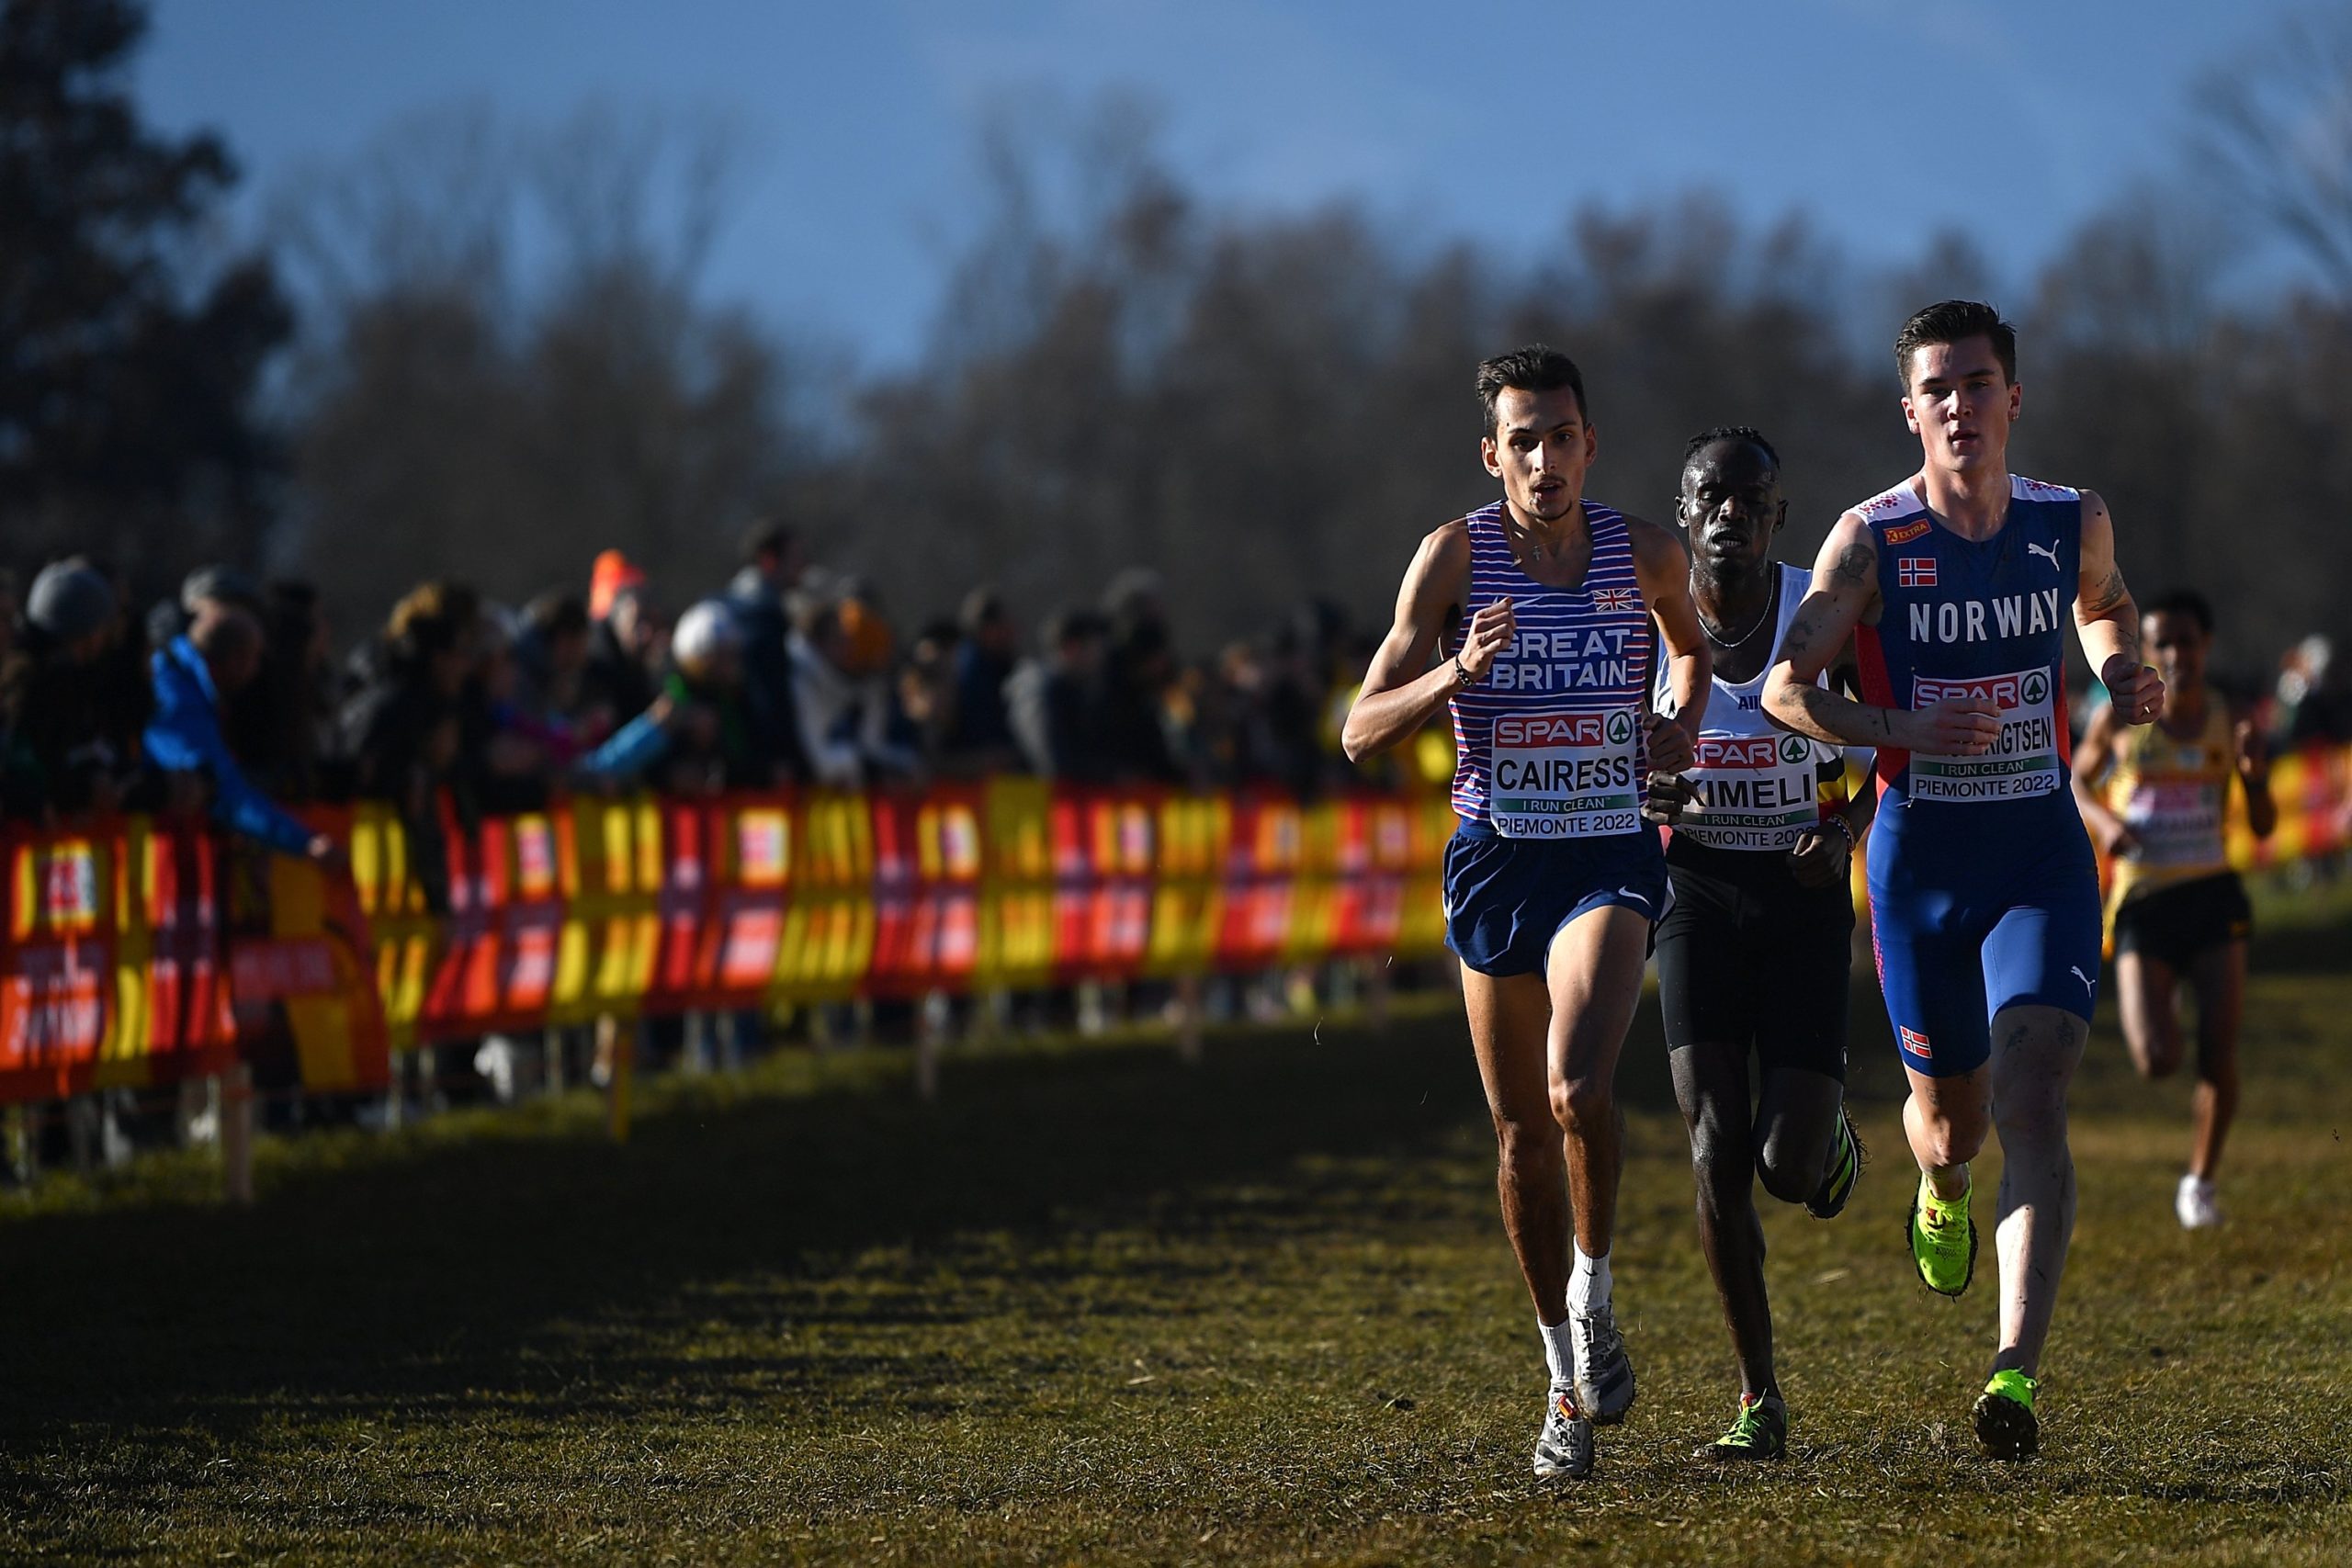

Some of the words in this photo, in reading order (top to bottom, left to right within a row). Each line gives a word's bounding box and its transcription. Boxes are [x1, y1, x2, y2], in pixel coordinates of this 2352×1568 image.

[1909, 587, 2059, 643] NORWAY
[1495, 628, 1631, 659] GREAT
[1491, 660, 1627, 690] BRITAIN
[1737, 694, 1762, 710] All
[1917, 682, 2016, 706] SPAR
[1498, 719, 1600, 744] SPAR
[1496, 755, 1630, 793] CAIRESS
[1940, 764, 1945, 774] I
[1948, 765, 1976, 776] RUN
[1981, 761, 2024, 774] CLEAN
[1916, 779, 2008, 797] PIEMONTE
[2012, 773, 2055, 794] 2022
[1523, 800, 1527, 811] I
[1531, 799, 1559, 812] RUN
[1563, 796, 1605, 812] CLEAN
[1498, 817, 1589, 835] PIEMONTE
[1593, 813, 1635, 831] 2022
[1704, 815, 1708, 824] I
[1712, 814, 1739, 826] RUN
[1742, 815, 1785, 827] CLEAN
[1684, 827, 1770, 846] PIEMONTE
[1773, 827, 1815, 845] 202
